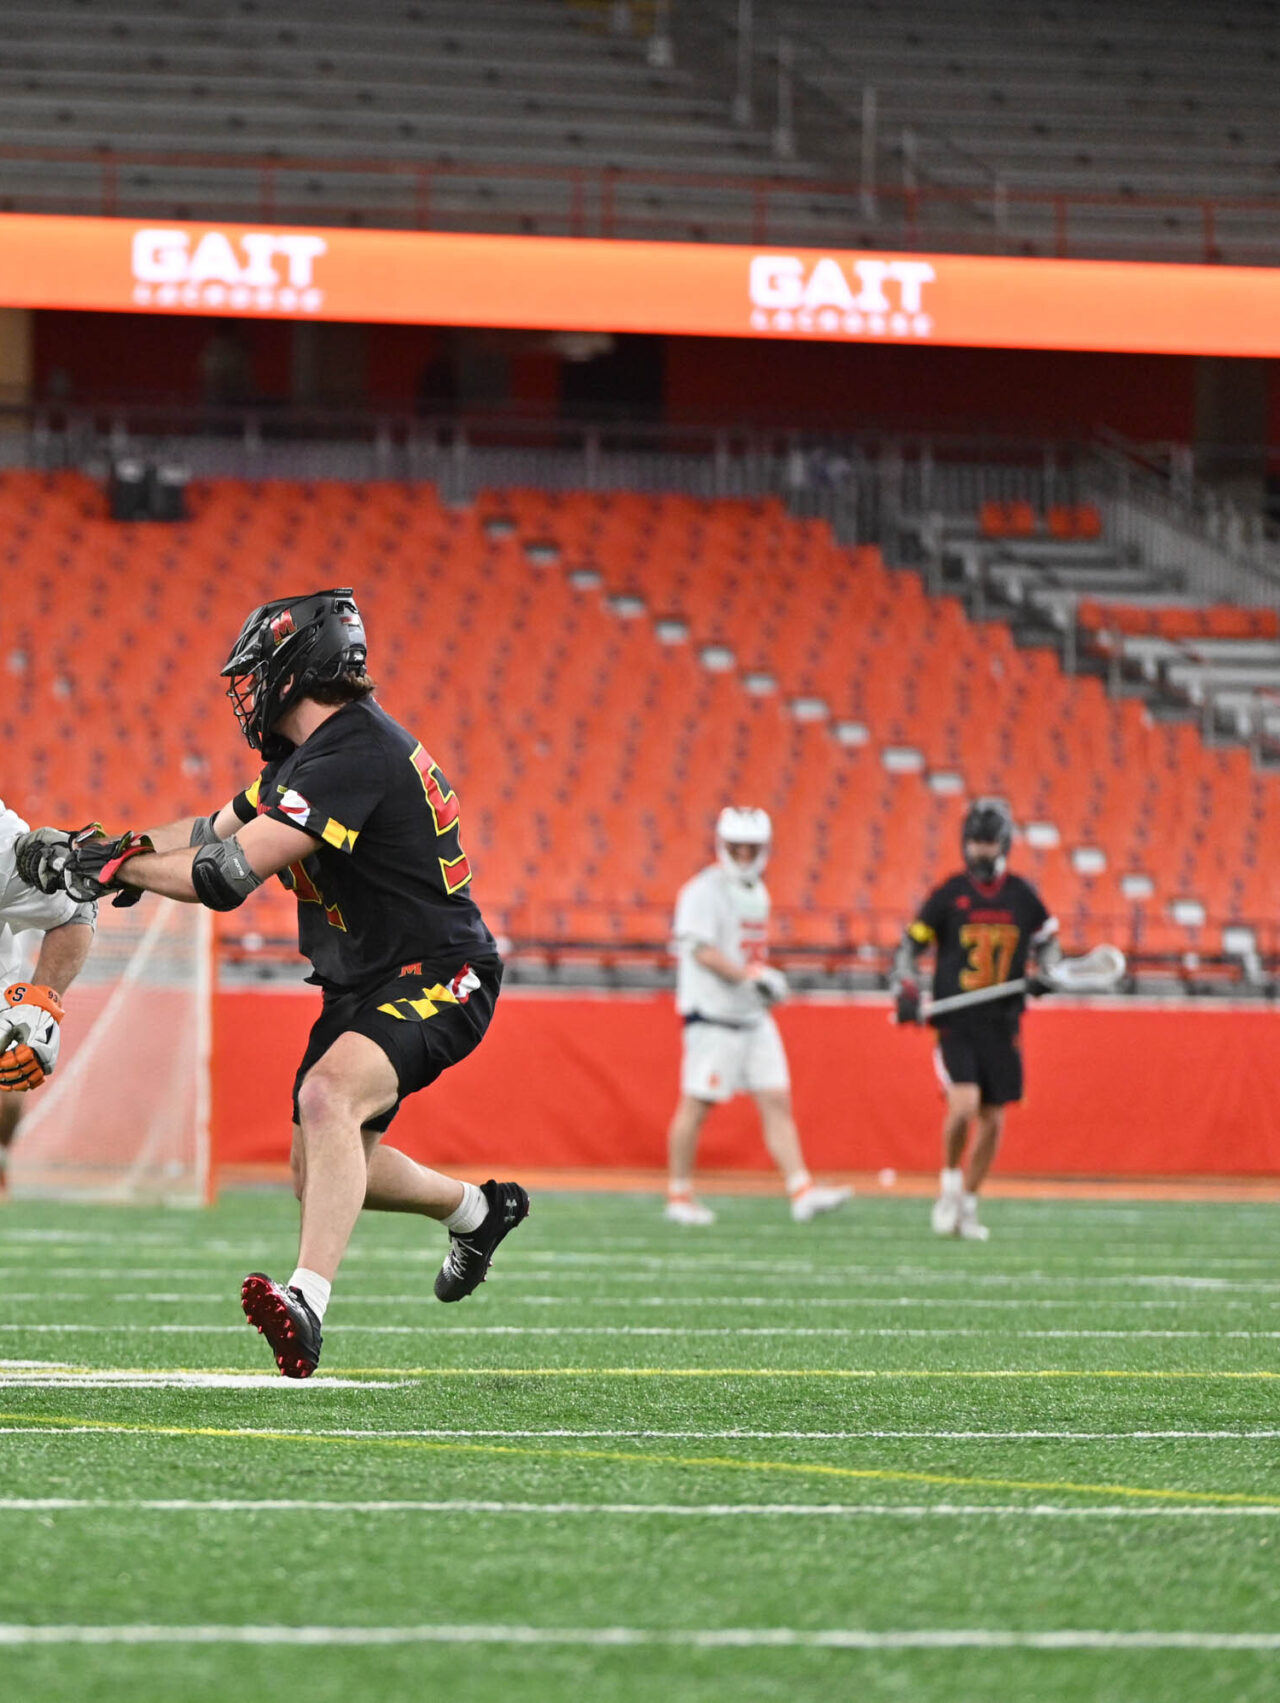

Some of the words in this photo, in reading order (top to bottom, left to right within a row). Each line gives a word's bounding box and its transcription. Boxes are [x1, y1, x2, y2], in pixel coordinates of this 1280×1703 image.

[131, 228, 327, 288] GAIT
[749, 255, 936, 314] GAIT
[959, 923, 1020, 991] 37
[11, 986, 27, 1003] S
